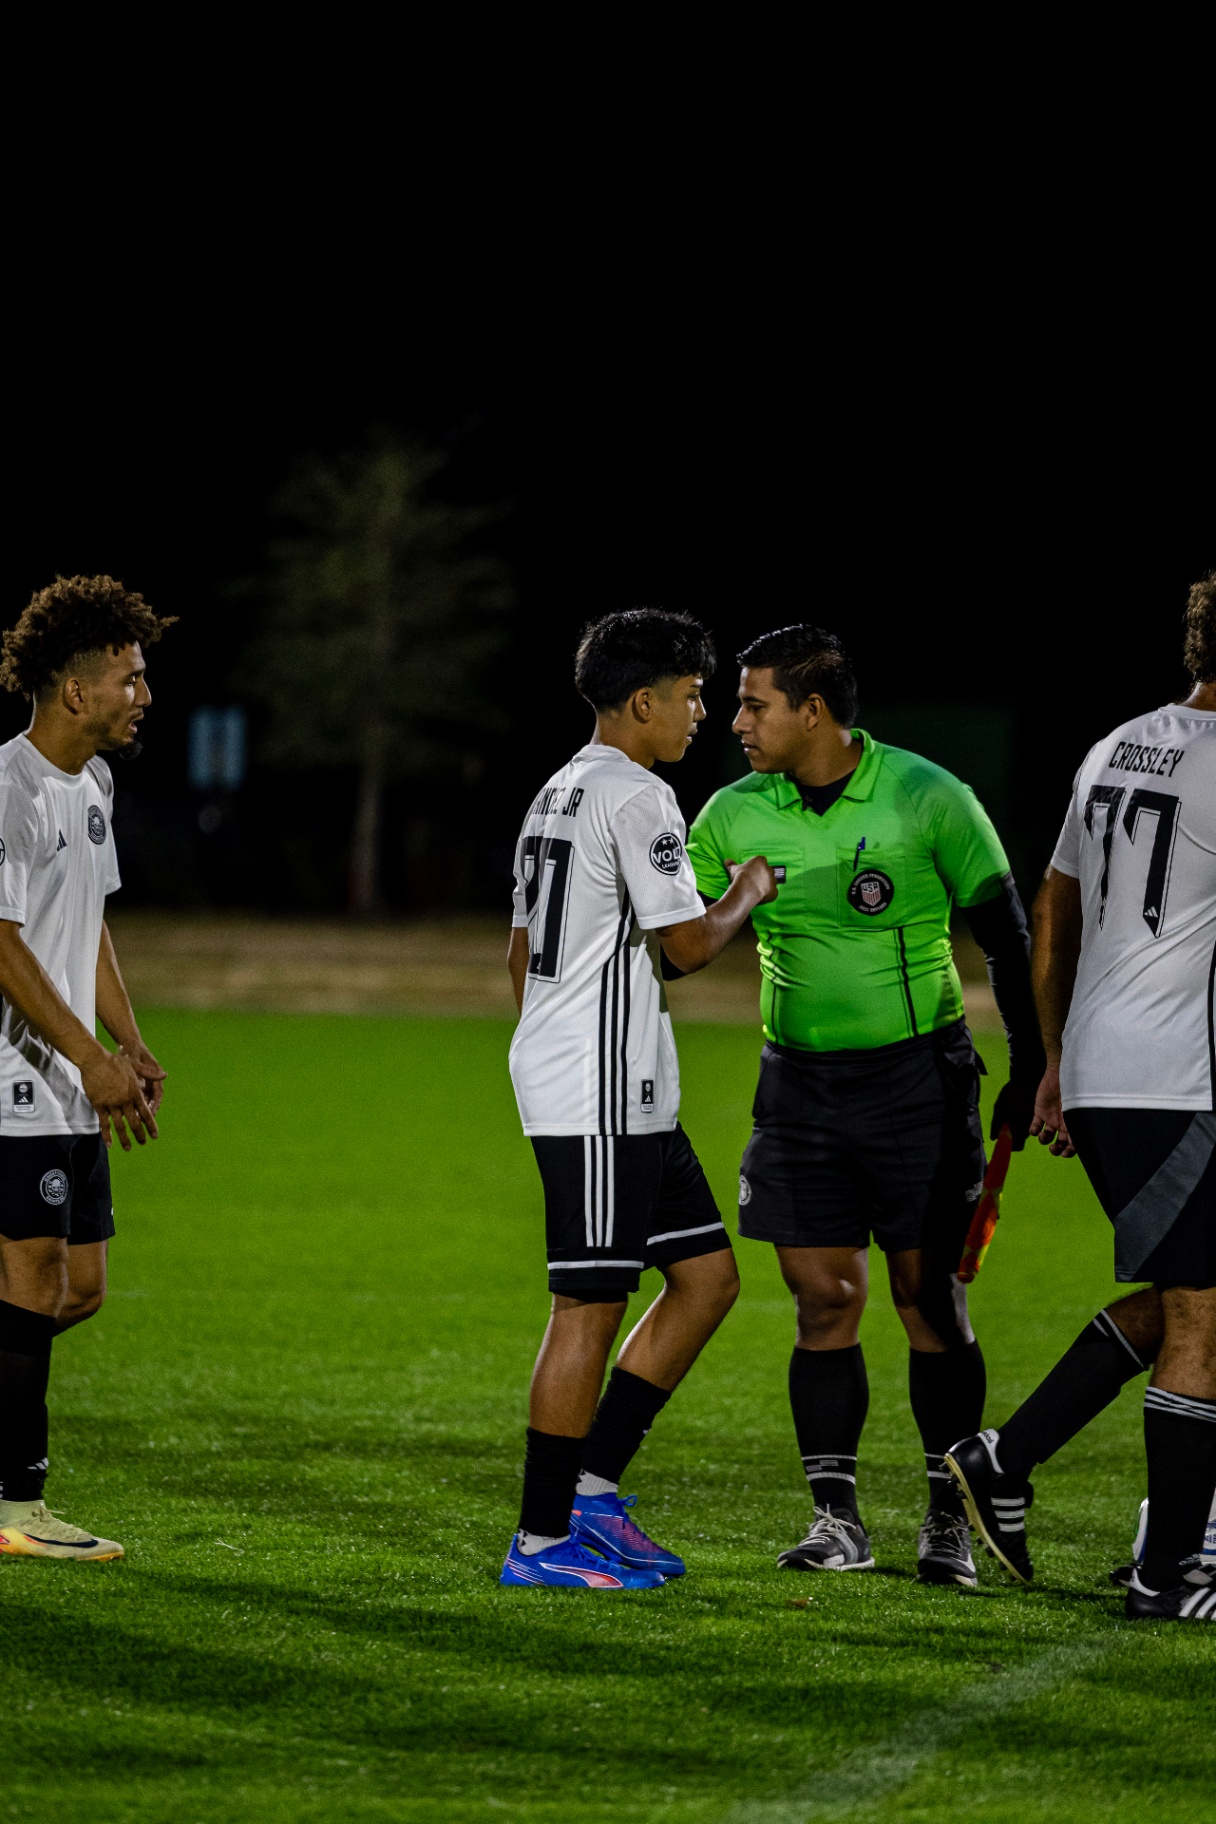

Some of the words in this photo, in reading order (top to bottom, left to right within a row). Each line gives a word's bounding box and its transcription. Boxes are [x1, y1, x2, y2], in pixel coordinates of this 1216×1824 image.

[1108, 741, 1185, 778] CROSSLEY
[562, 787, 585, 818] JR
[1084, 785, 1182, 939] 77
[863, 883, 878, 892] USA
